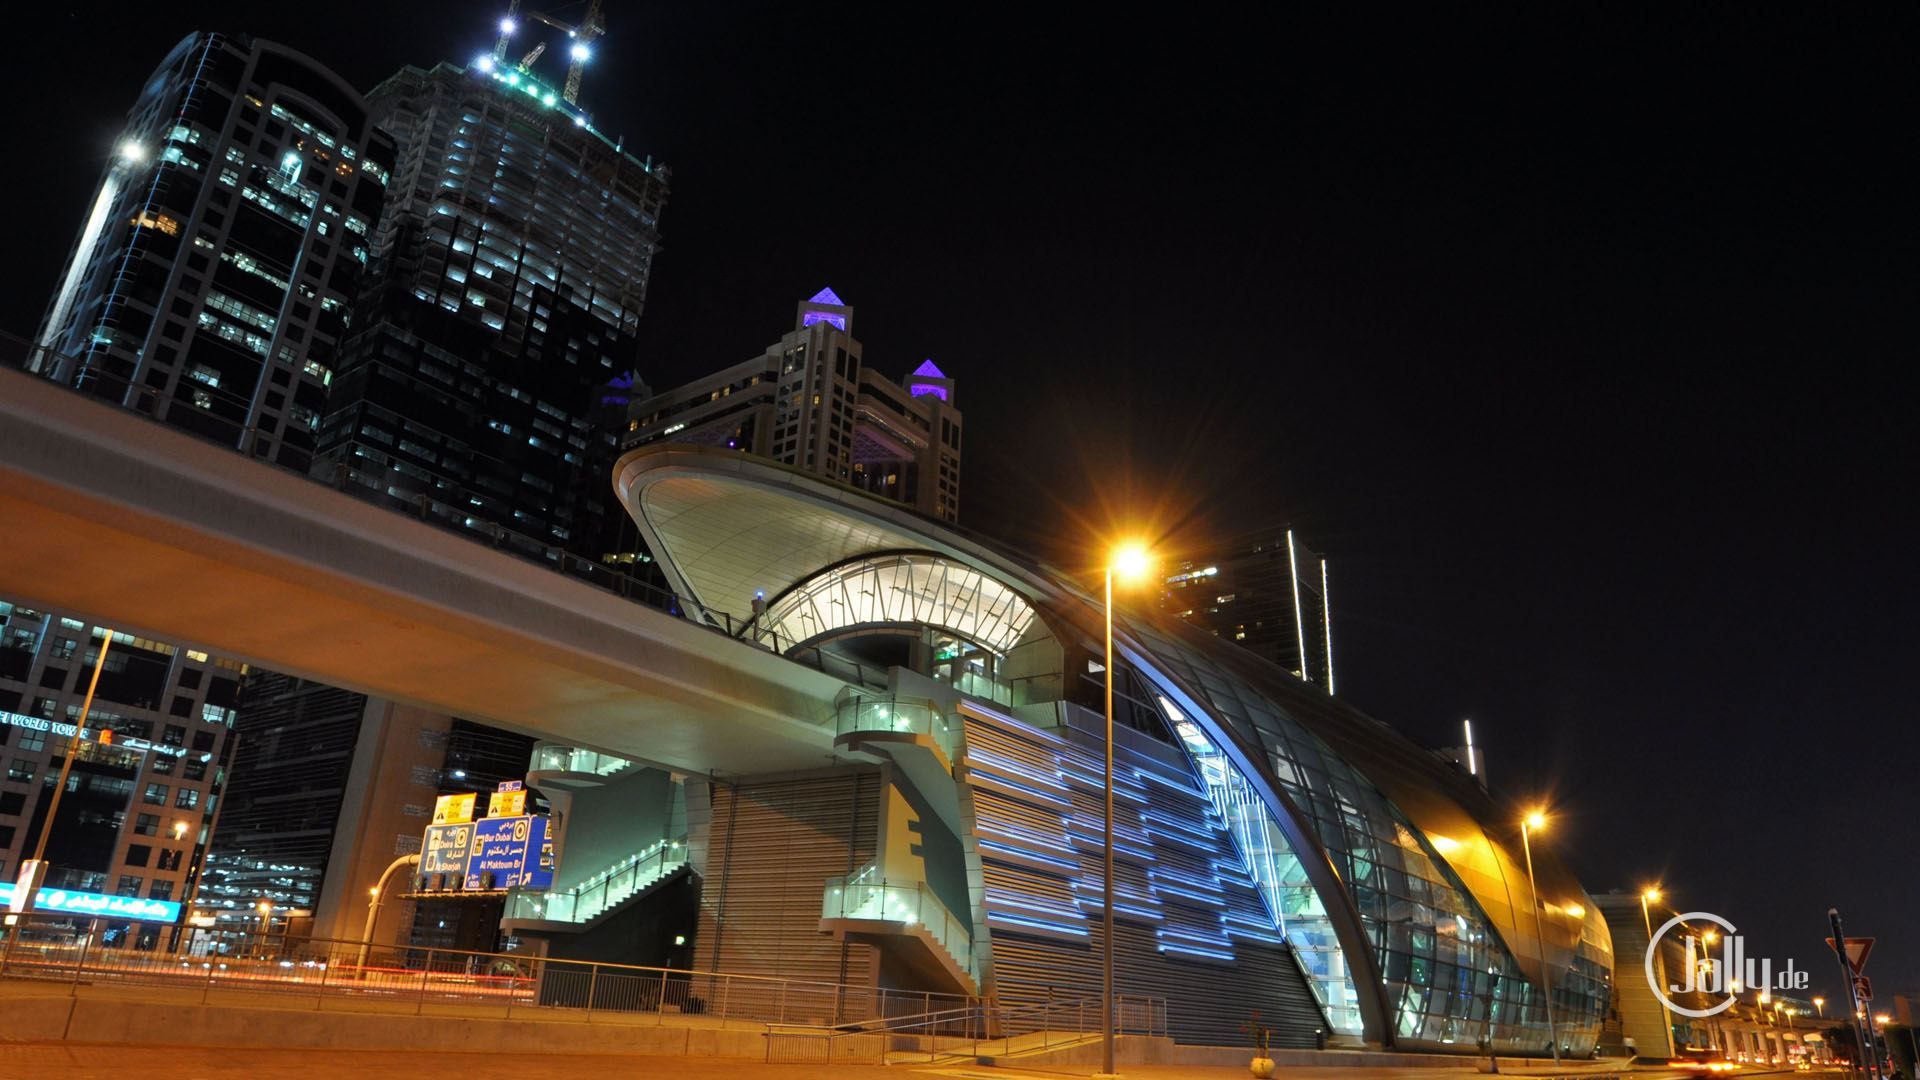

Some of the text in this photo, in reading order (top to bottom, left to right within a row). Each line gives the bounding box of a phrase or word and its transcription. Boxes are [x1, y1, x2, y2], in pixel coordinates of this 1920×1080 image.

[10, 713, 51, 732] WORLD
[51, 721, 90, 739] TOWR
[494, 832, 512, 842] Dubai
[486, 860, 513, 869] Maktoum
[513, 859, 522, 869] Br
